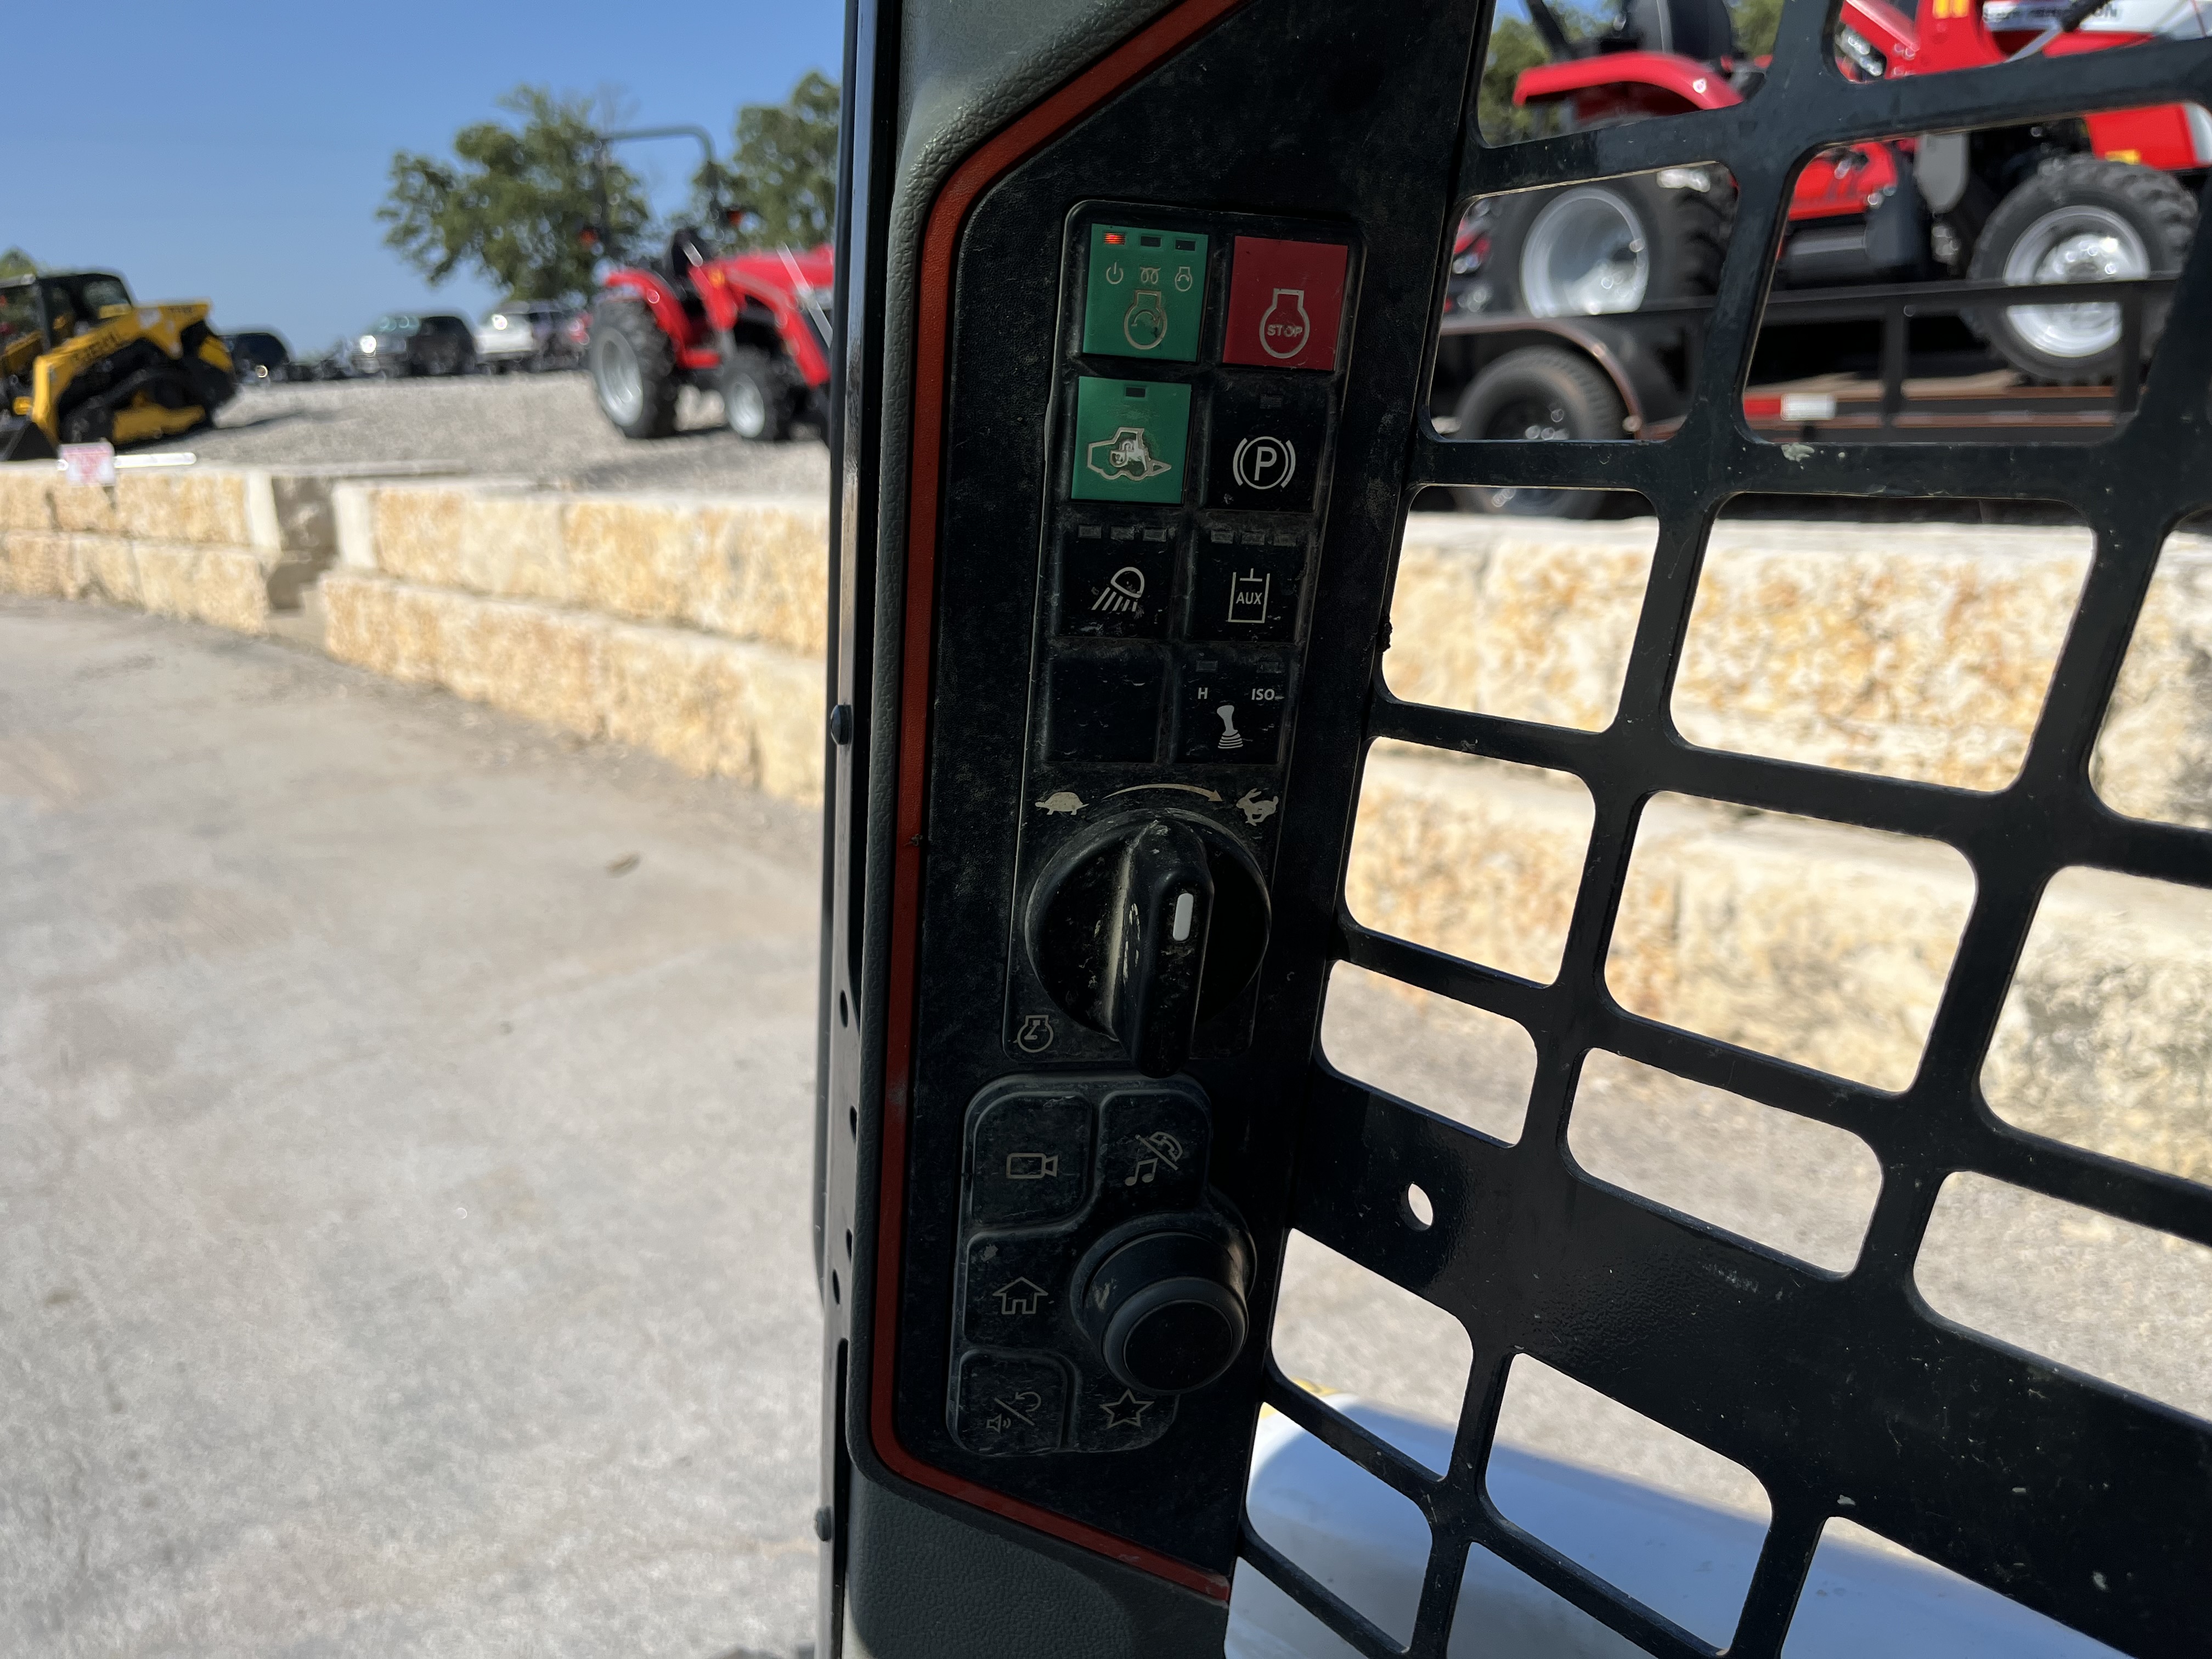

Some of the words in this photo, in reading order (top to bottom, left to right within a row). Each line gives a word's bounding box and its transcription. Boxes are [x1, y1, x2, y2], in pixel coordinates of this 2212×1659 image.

[1267, 324, 1303, 337] STOP
[1254, 447, 1277, 481] P
[1235, 592, 1262, 605] AUX
[1198, 687, 1208, 699] H
[1251, 689, 1275, 701] ISO
